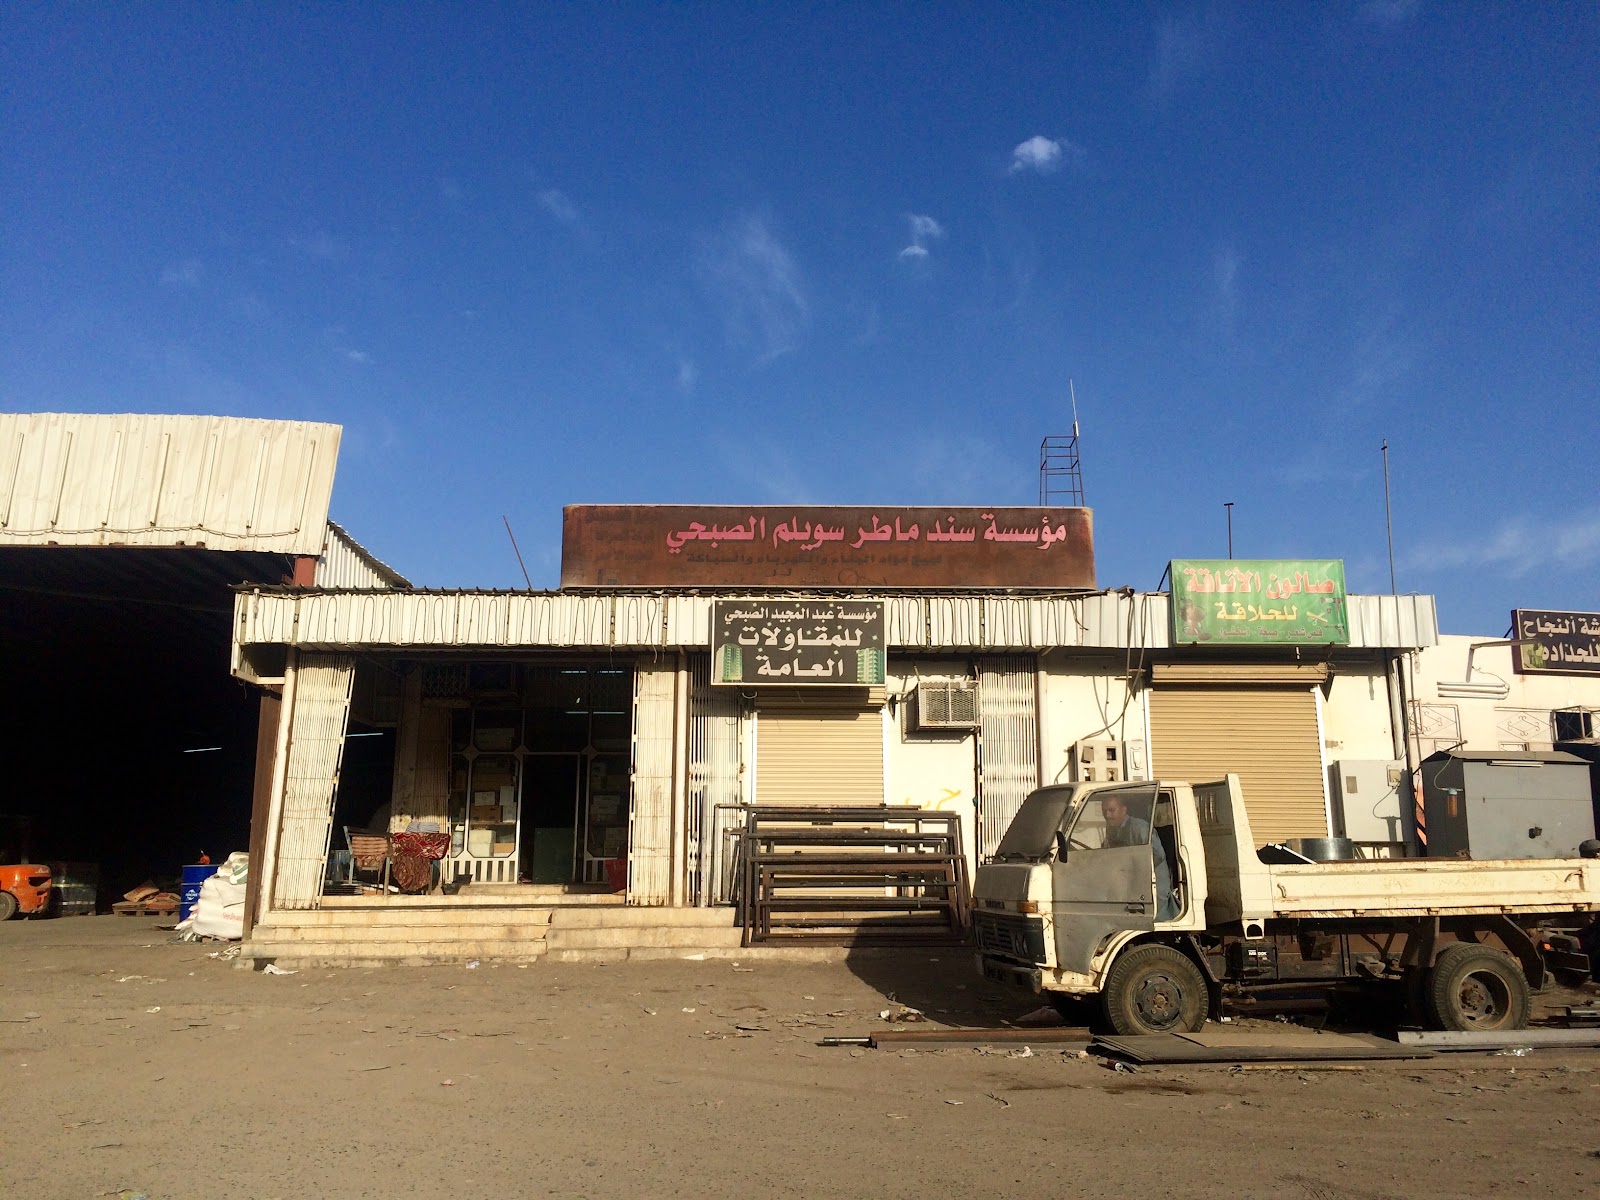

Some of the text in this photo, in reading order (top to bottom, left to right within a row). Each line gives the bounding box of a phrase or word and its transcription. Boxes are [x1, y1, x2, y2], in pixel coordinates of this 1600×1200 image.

[666, 512, 1067, 555] مؤسسة سند ماطر سويلم الصبحي
[1183, 567, 1335, 600] صالون الأناقة
[724, 605, 878, 625] مؤسسة عبد المجيد الصبحي
[1214, 601, 1298, 622] للحلاقة
[737, 625, 864, 651] للمقاولات
[1523, 616, 1576, 638] النجاح
[755, 655, 844, 677] العامة
